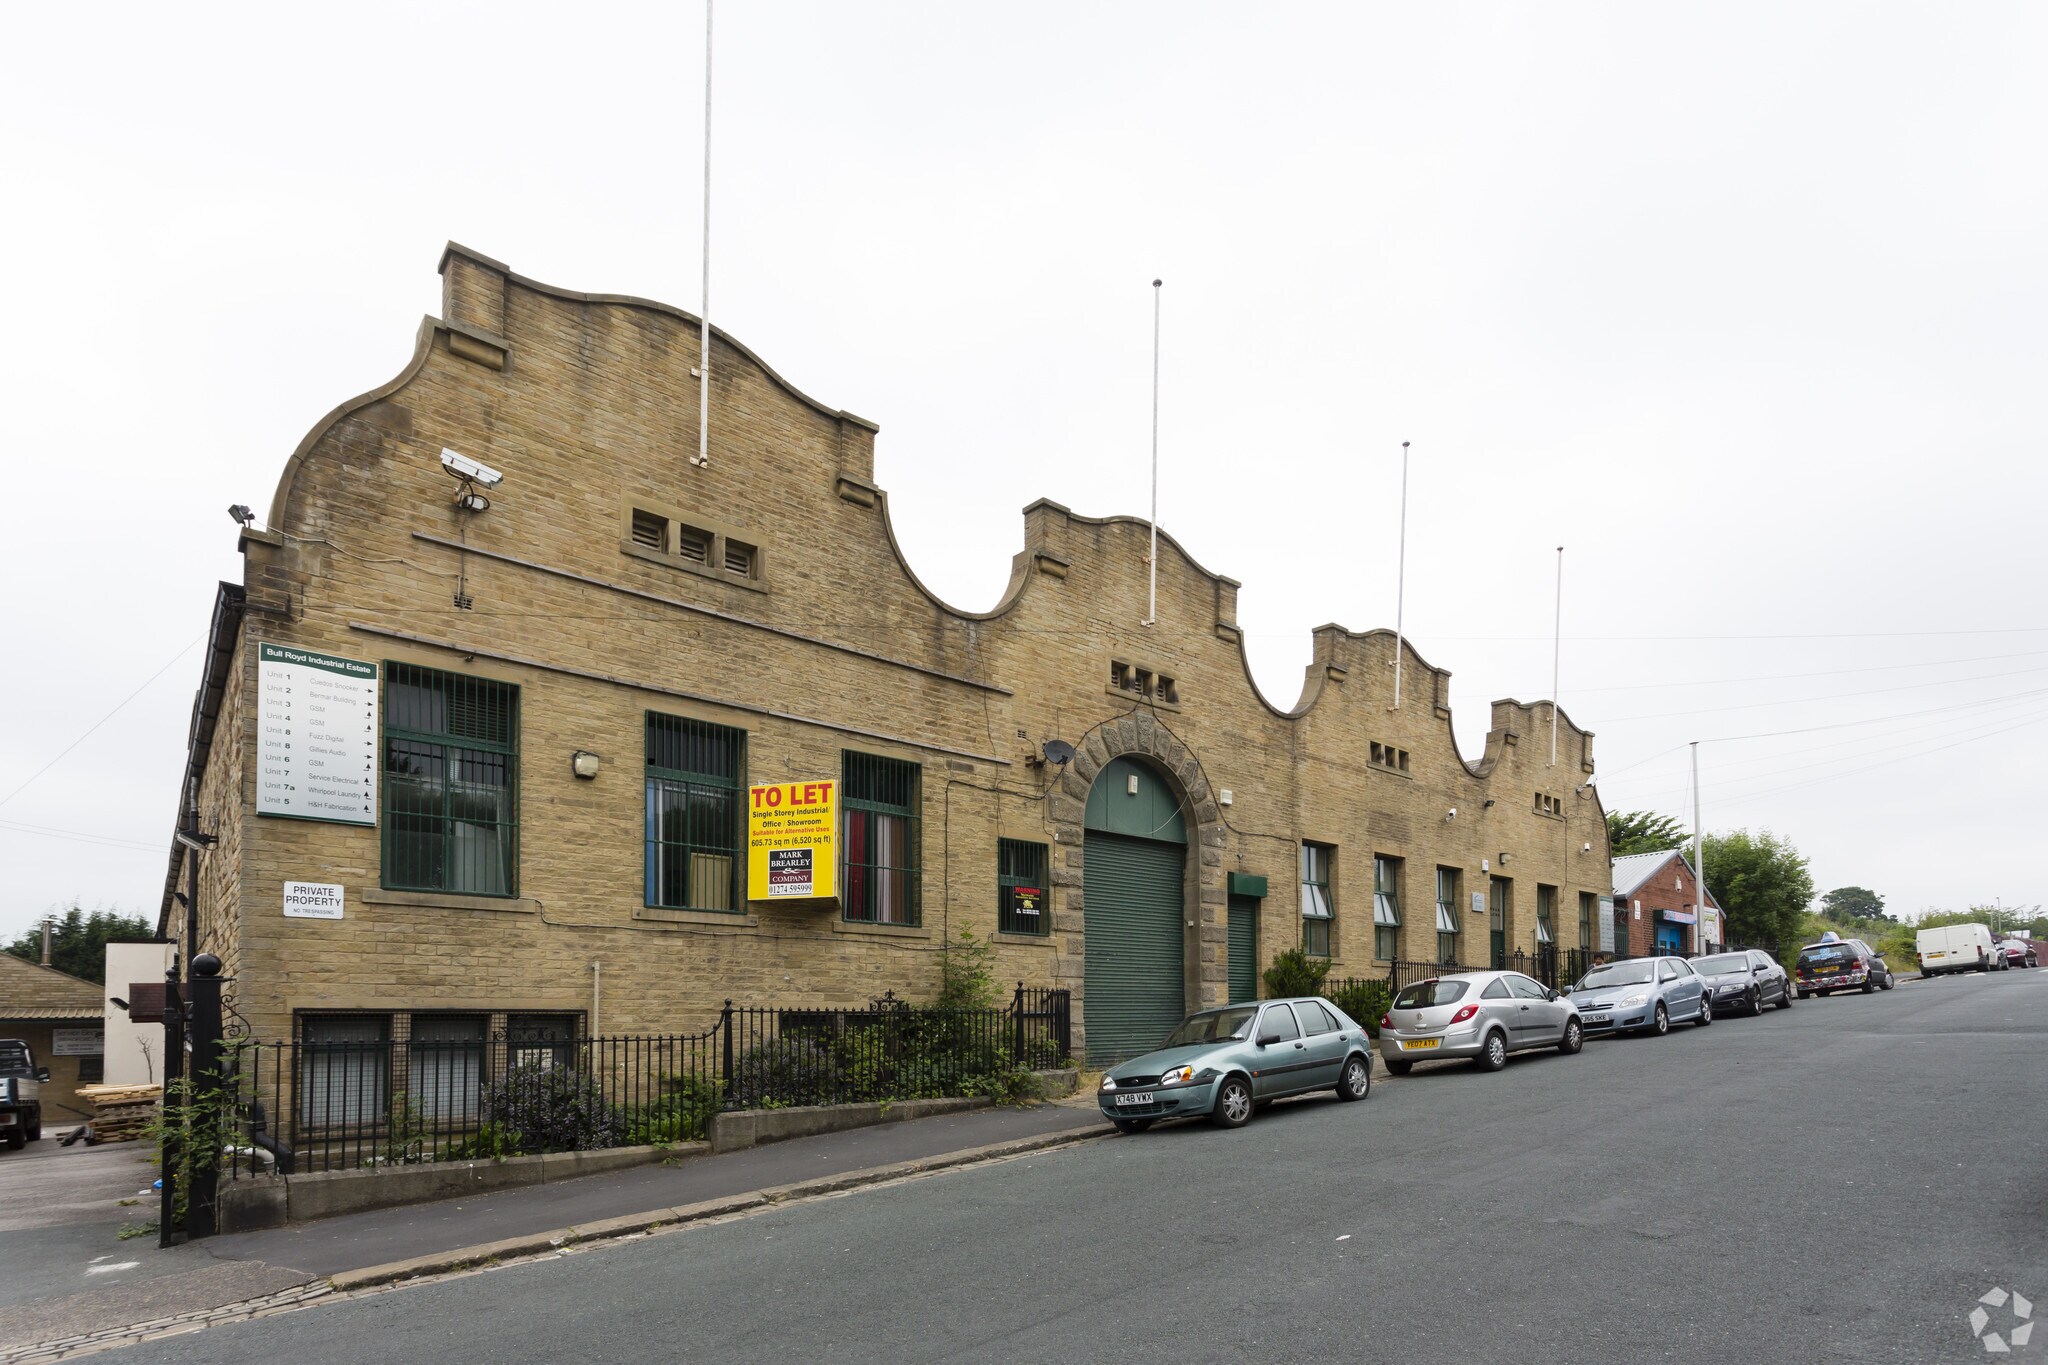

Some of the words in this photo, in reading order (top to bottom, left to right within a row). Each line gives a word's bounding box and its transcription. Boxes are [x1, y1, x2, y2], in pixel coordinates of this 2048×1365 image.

[266, 648, 283, 657] Bull
[285, 652, 306, 662] Royd
[309, 656, 344, 669] Industrial
[347, 664, 371, 674] Estate
[267, 684, 283, 692] Unit
[334, 696, 356, 706] Building
[308, 773, 331, 781] Service
[332, 776, 359, 785] Electrical
[308, 787, 336, 796] Whirlpool
[338, 791, 361, 799] Laundry
[752, 787, 782, 808] TO
[790, 783, 832, 805] LET
[324, 803, 356, 812] Fabrication
[771, 859, 810, 867] BREARLEY
[294, 886, 334, 896] PRIVATE
[790, 884, 812, 892] 595999
[286, 896, 341, 906] PROPERTY
[1117, 1095, 1135, 1103] X748
[1137, 1093, 1152, 1102] VWX
